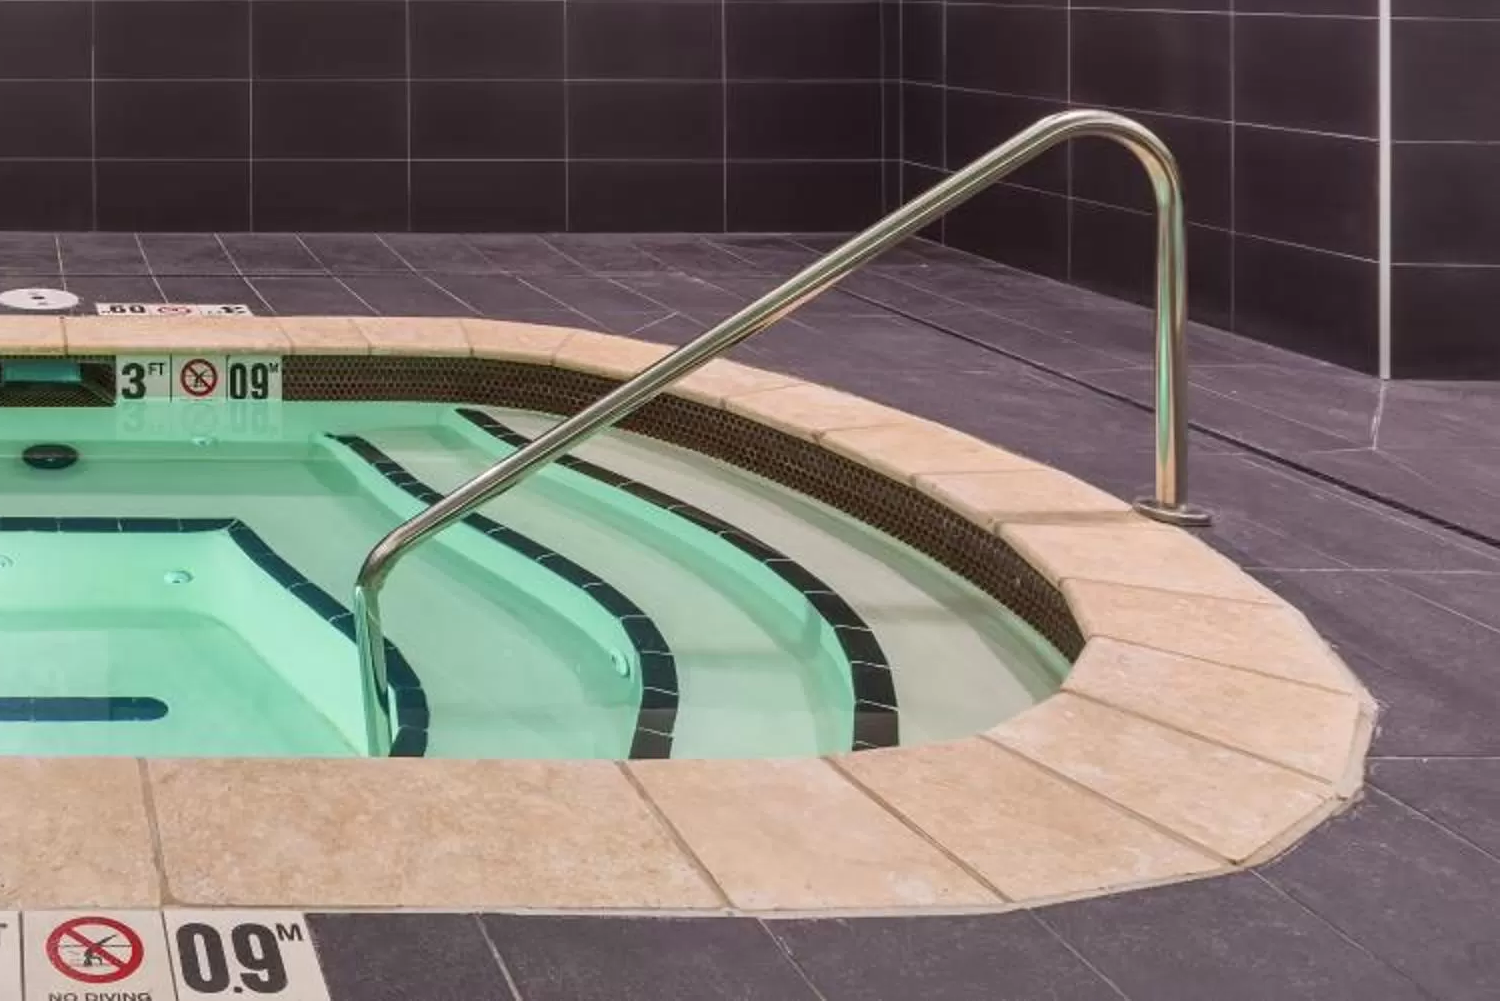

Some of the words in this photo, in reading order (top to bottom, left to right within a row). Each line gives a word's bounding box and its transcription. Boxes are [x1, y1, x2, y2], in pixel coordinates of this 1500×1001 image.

[121, 362, 146, 399] 3
[148, 362, 166, 376] FT
[175, 922, 289, 994] 0.9
[274, 923, 304, 942] M
